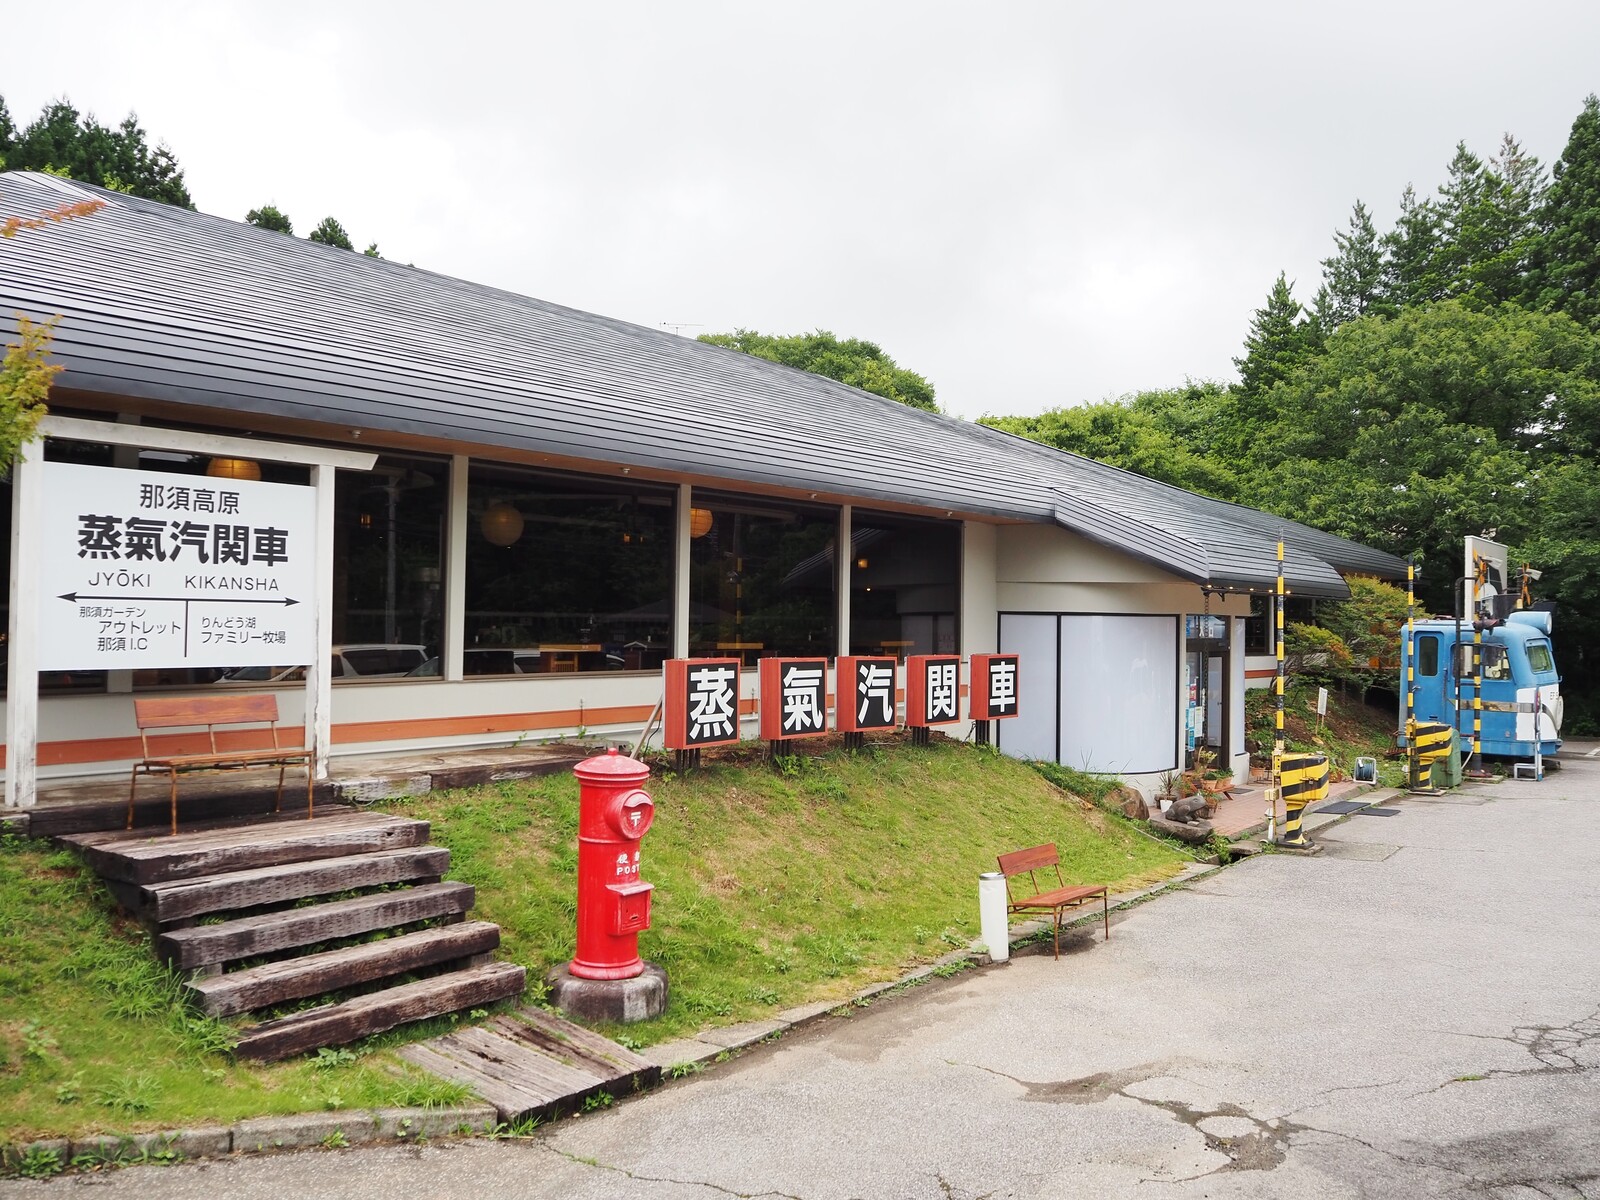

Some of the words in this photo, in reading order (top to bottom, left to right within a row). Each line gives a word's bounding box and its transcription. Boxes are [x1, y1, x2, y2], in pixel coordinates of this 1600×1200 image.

[140, 483, 240, 515] 那須高原
[77, 514, 289, 567] 蒸氣汽関車
[88, 569, 151, 588] JYŌKI
[185, 575, 279, 591] KIKANSHA
[79, 606, 146, 618] 那須ガーデン
[99, 621, 181, 634] アウトレット
[201, 616, 256, 629] りんどう湖
[201, 631, 286, 644] ファミリー牧場
